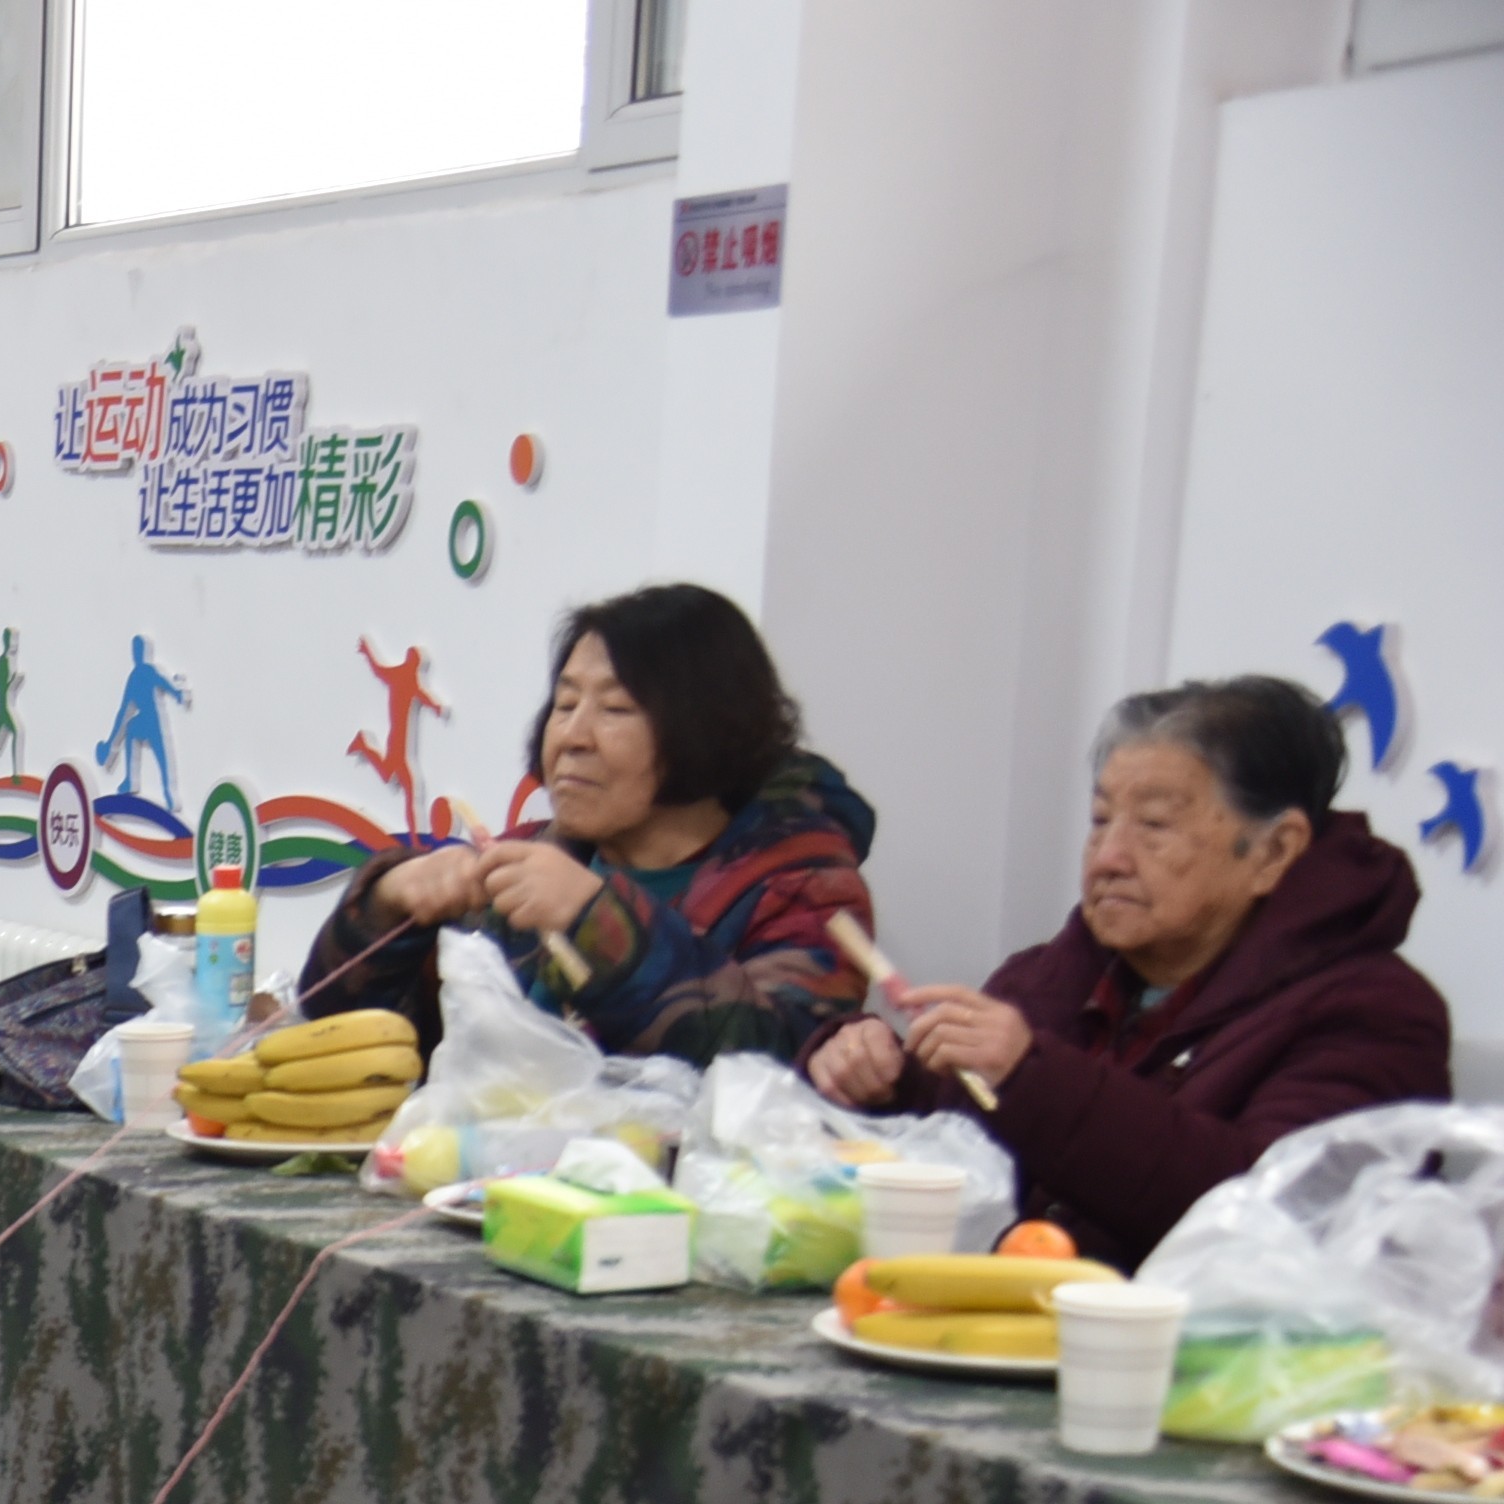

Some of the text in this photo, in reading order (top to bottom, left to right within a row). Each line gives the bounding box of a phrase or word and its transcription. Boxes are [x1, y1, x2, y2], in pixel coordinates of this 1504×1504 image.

[703, 221, 779, 273] 禁止吸烟
[55, 363, 294, 462] 让运动成为习惯
[140, 432, 403, 542] 让生活更加精彩
[49, 809, 80, 848] 快乐
[209, 832, 242, 867] 健康
